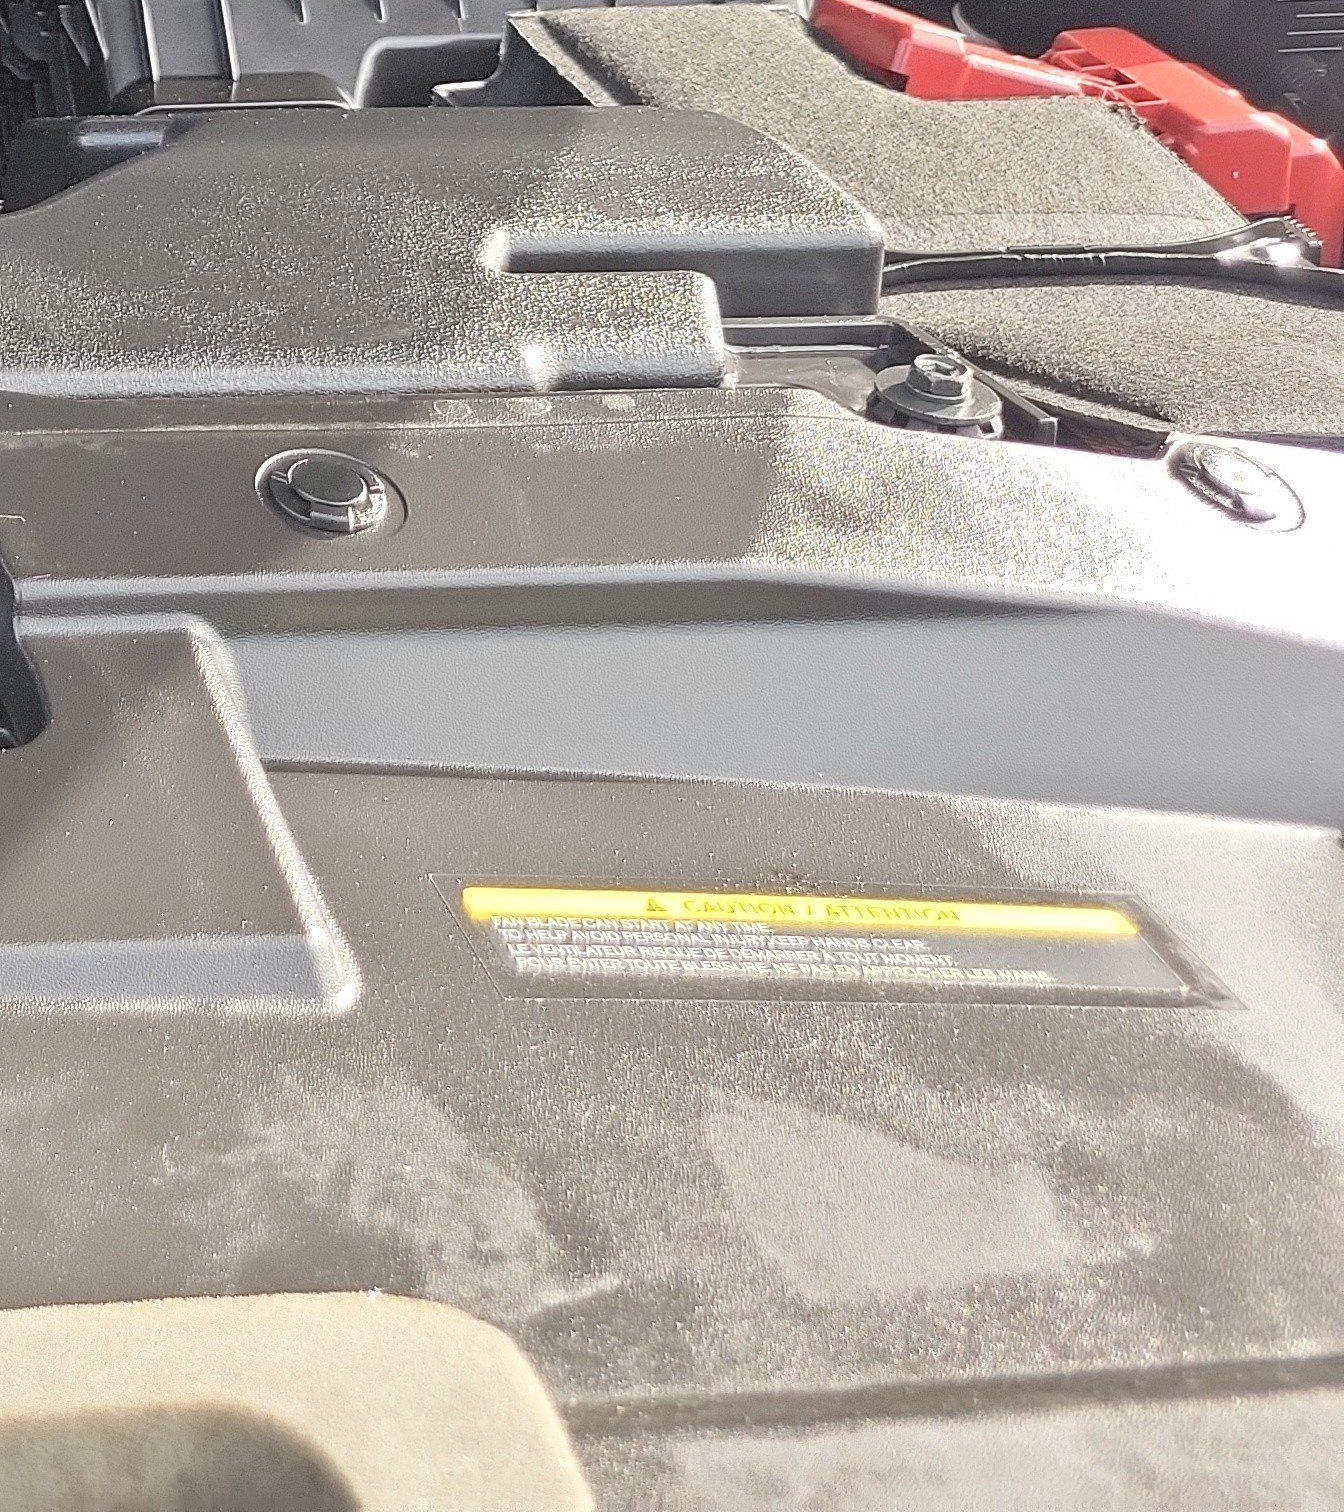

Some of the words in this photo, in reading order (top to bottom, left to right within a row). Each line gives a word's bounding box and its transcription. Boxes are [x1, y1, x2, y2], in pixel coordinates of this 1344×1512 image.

[683, 900, 796, 916] CAUTION
[826, 904, 960, 921] ATTENTION
[490, 915, 524, 928] FAN
[525, 916, 582, 929] BLADE
[581, 917, 619, 930] CAN
[619, 919, 670, 932] START
[674, 920, 694, 932] AT
[696, 921, 729, 933] ANY
[730, 922, 775, 934] TIME.
[496, 928, 523, 941] TO
[523, 929, 568, 942] HELP
[571, 930, 621, 943] AVOID
[622, 931, 712, 945] PERSONAL
[766, 935, 809, 947] KEEP
[810, 936, 871, 950] HANDS
[871, 938, 931, 951] CLEAR.
[507, 943, 532, 955] LE
[531, 944, 639, 957] VENTILATEUR
[638, 945, 704, 959] RISQUE
[703, 948, 729, 960] DE
[729, 946, 822, 961] DÉMARRER
[835, 951, 879, 964] TOUT
[879, 953, 959, 967] MOMENT.
[515, 956, 565, 969] POUR
[566, 955, 624, 970] ÉVITER
[624, 958, 682, 972] TOUTE
[681, 960, 772, 976] BLESSURE,
[771, 962, 800, 974] NE
[798, 963, 834, 976] PAS
[833, 964, 859, 976] EN
[861, 965, 965, 979] APPROCHER
[965, 968, 998, 980] LES
